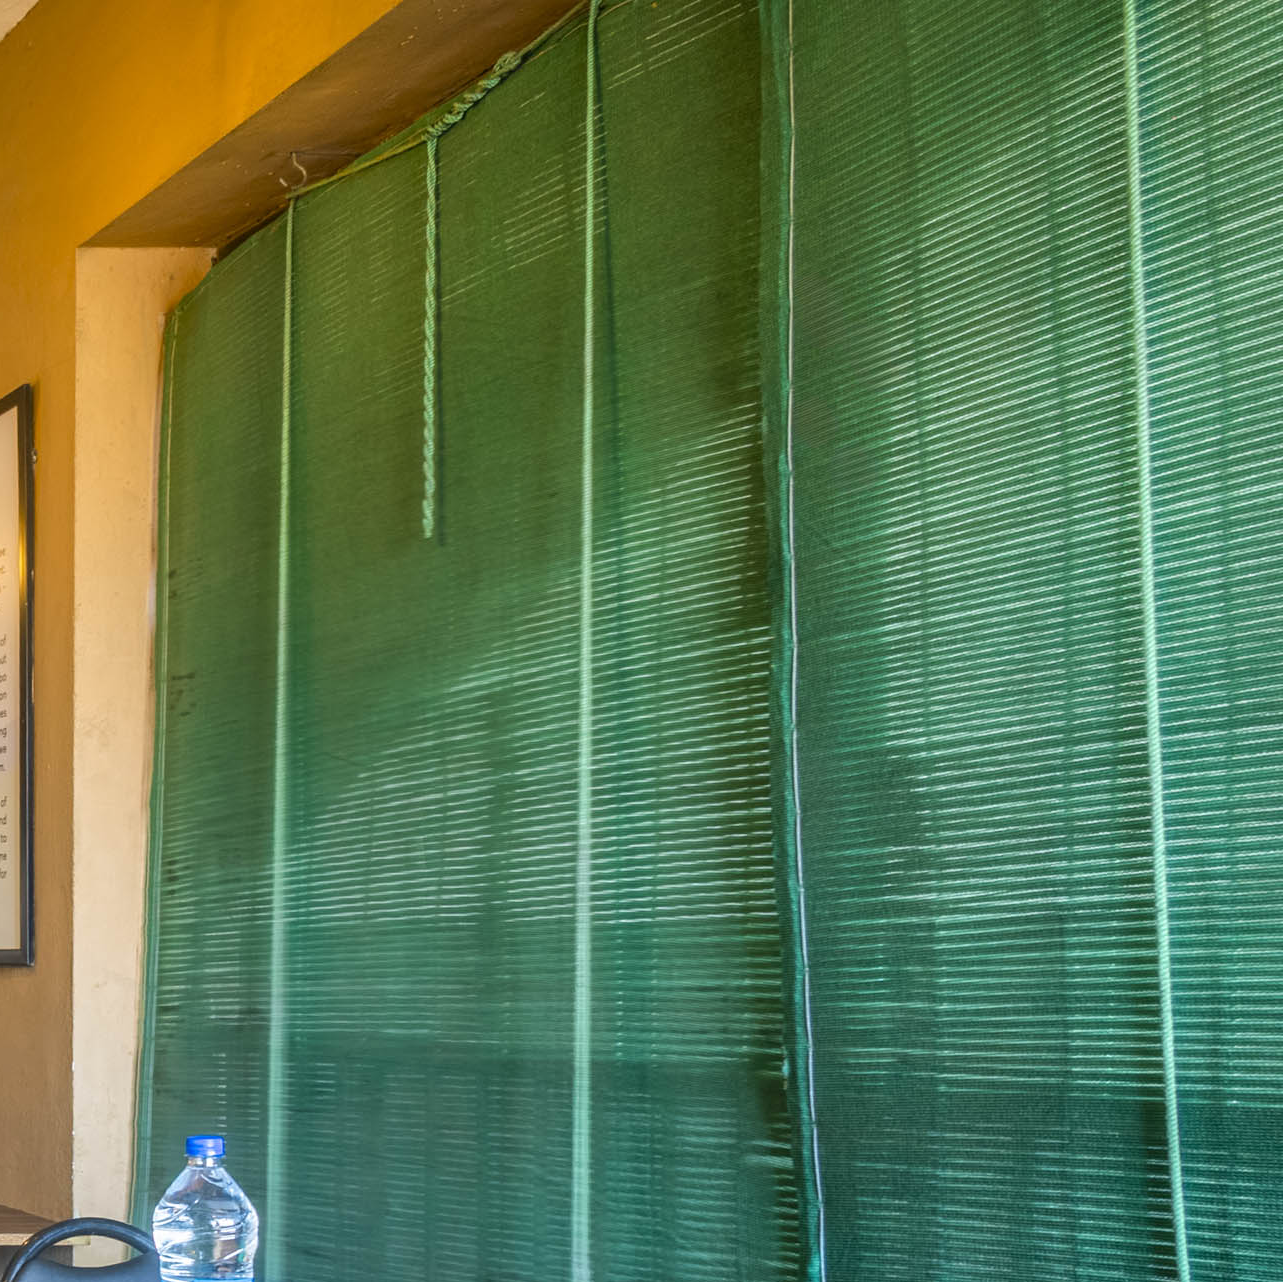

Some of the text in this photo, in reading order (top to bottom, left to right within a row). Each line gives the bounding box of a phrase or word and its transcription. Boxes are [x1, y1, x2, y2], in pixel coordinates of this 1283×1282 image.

[0, 635, 6, 647] of
[0, 797, 6, 808] of
[0, 833, 7, 843] to
